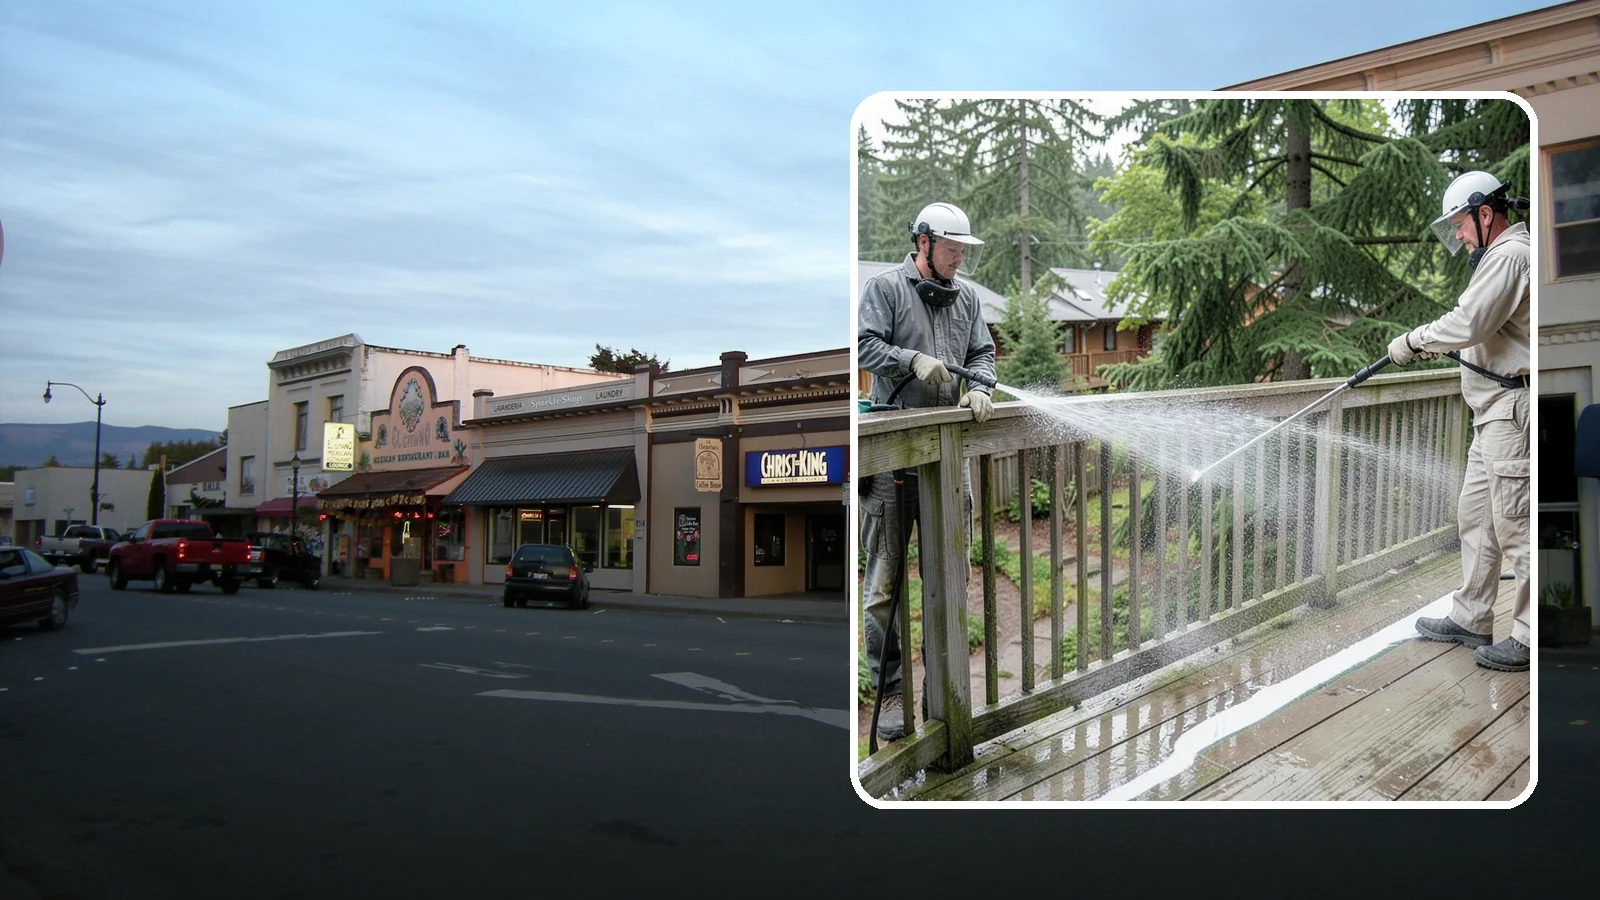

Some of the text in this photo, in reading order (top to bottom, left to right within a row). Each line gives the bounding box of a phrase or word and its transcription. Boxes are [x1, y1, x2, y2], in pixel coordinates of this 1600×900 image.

[493, 389, 624, 413] LAVANDERIA Sparkle Shop LAUNDRY
[373, 455, 396, 464] MEXICAN
[397, 451, 433, 462] RESTAURANT
[438, 450, 450, 459] BAR
[760, 450, 827, 478] CHRIST KING
